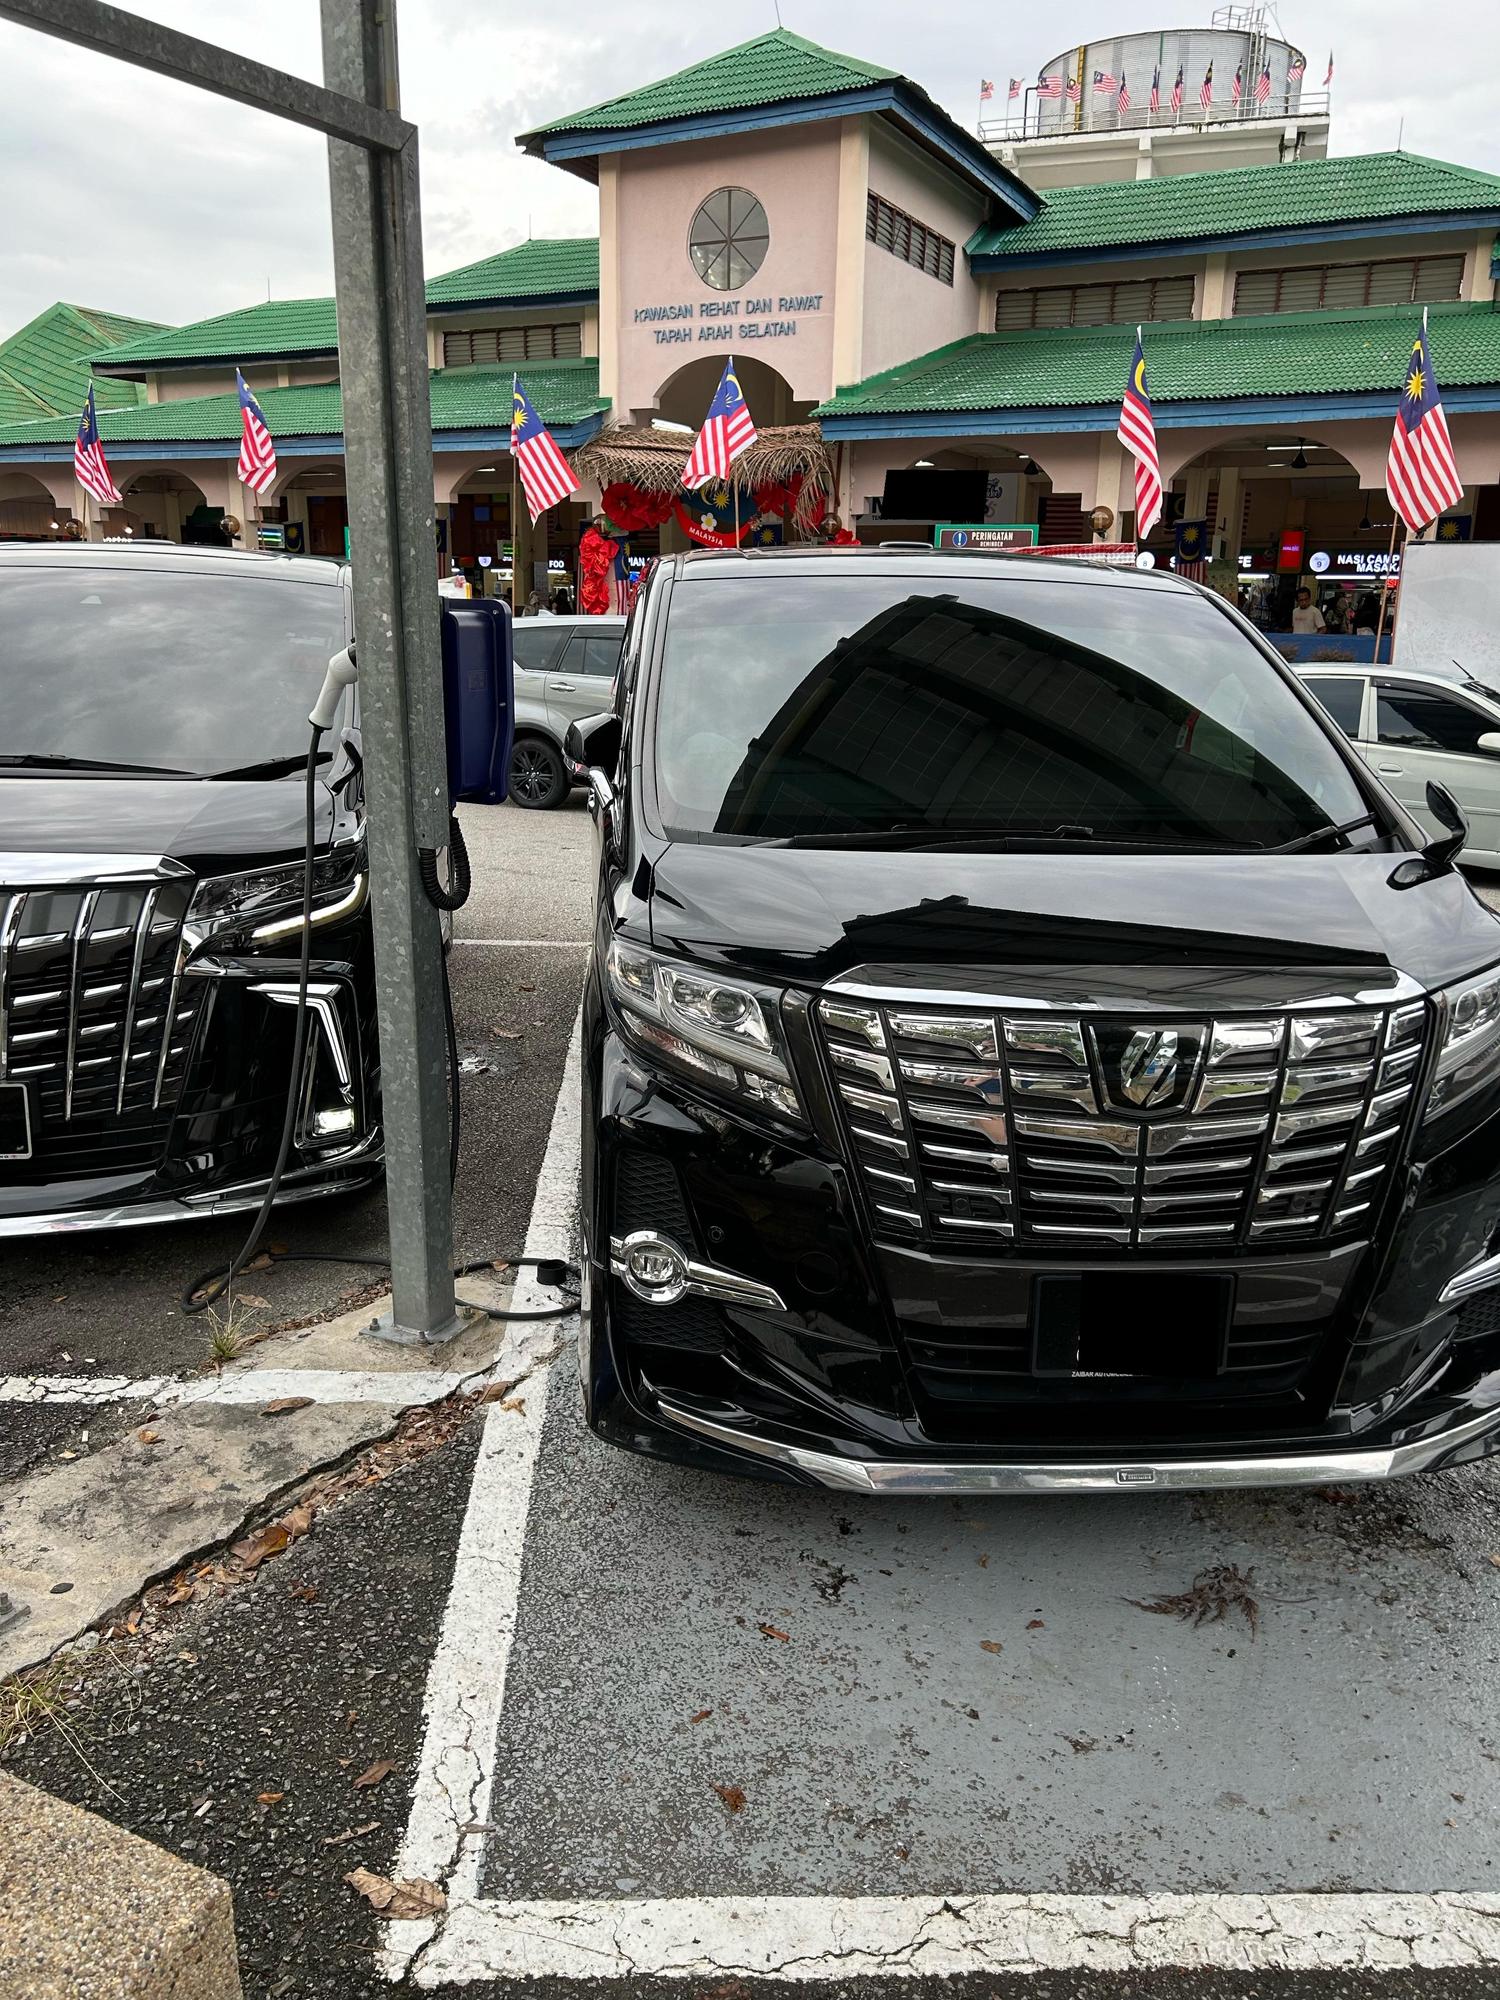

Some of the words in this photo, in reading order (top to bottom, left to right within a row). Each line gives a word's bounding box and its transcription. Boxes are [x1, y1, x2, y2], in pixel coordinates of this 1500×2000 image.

[634, 304, 693, 322] KAWASAN
[700, 301, 740, 317] REHAT
[746, 298, 772, 314] DAN
[778, 295, 823, 312] RAWAT
[653, 328, 692, 344] TAPAH
[698, 325, 732, 341] ARAH
[739, 321, 796, 338] SELATAN
[689, 527, 723, 546] MALAYSIA
[971, 531, 1014, 541] PERINGATAN
[1337, 555, 1364, 564] NASI
[1367, 555, 1400, 564] CAMP
[1356, 563, 1400, 573] MASAK
